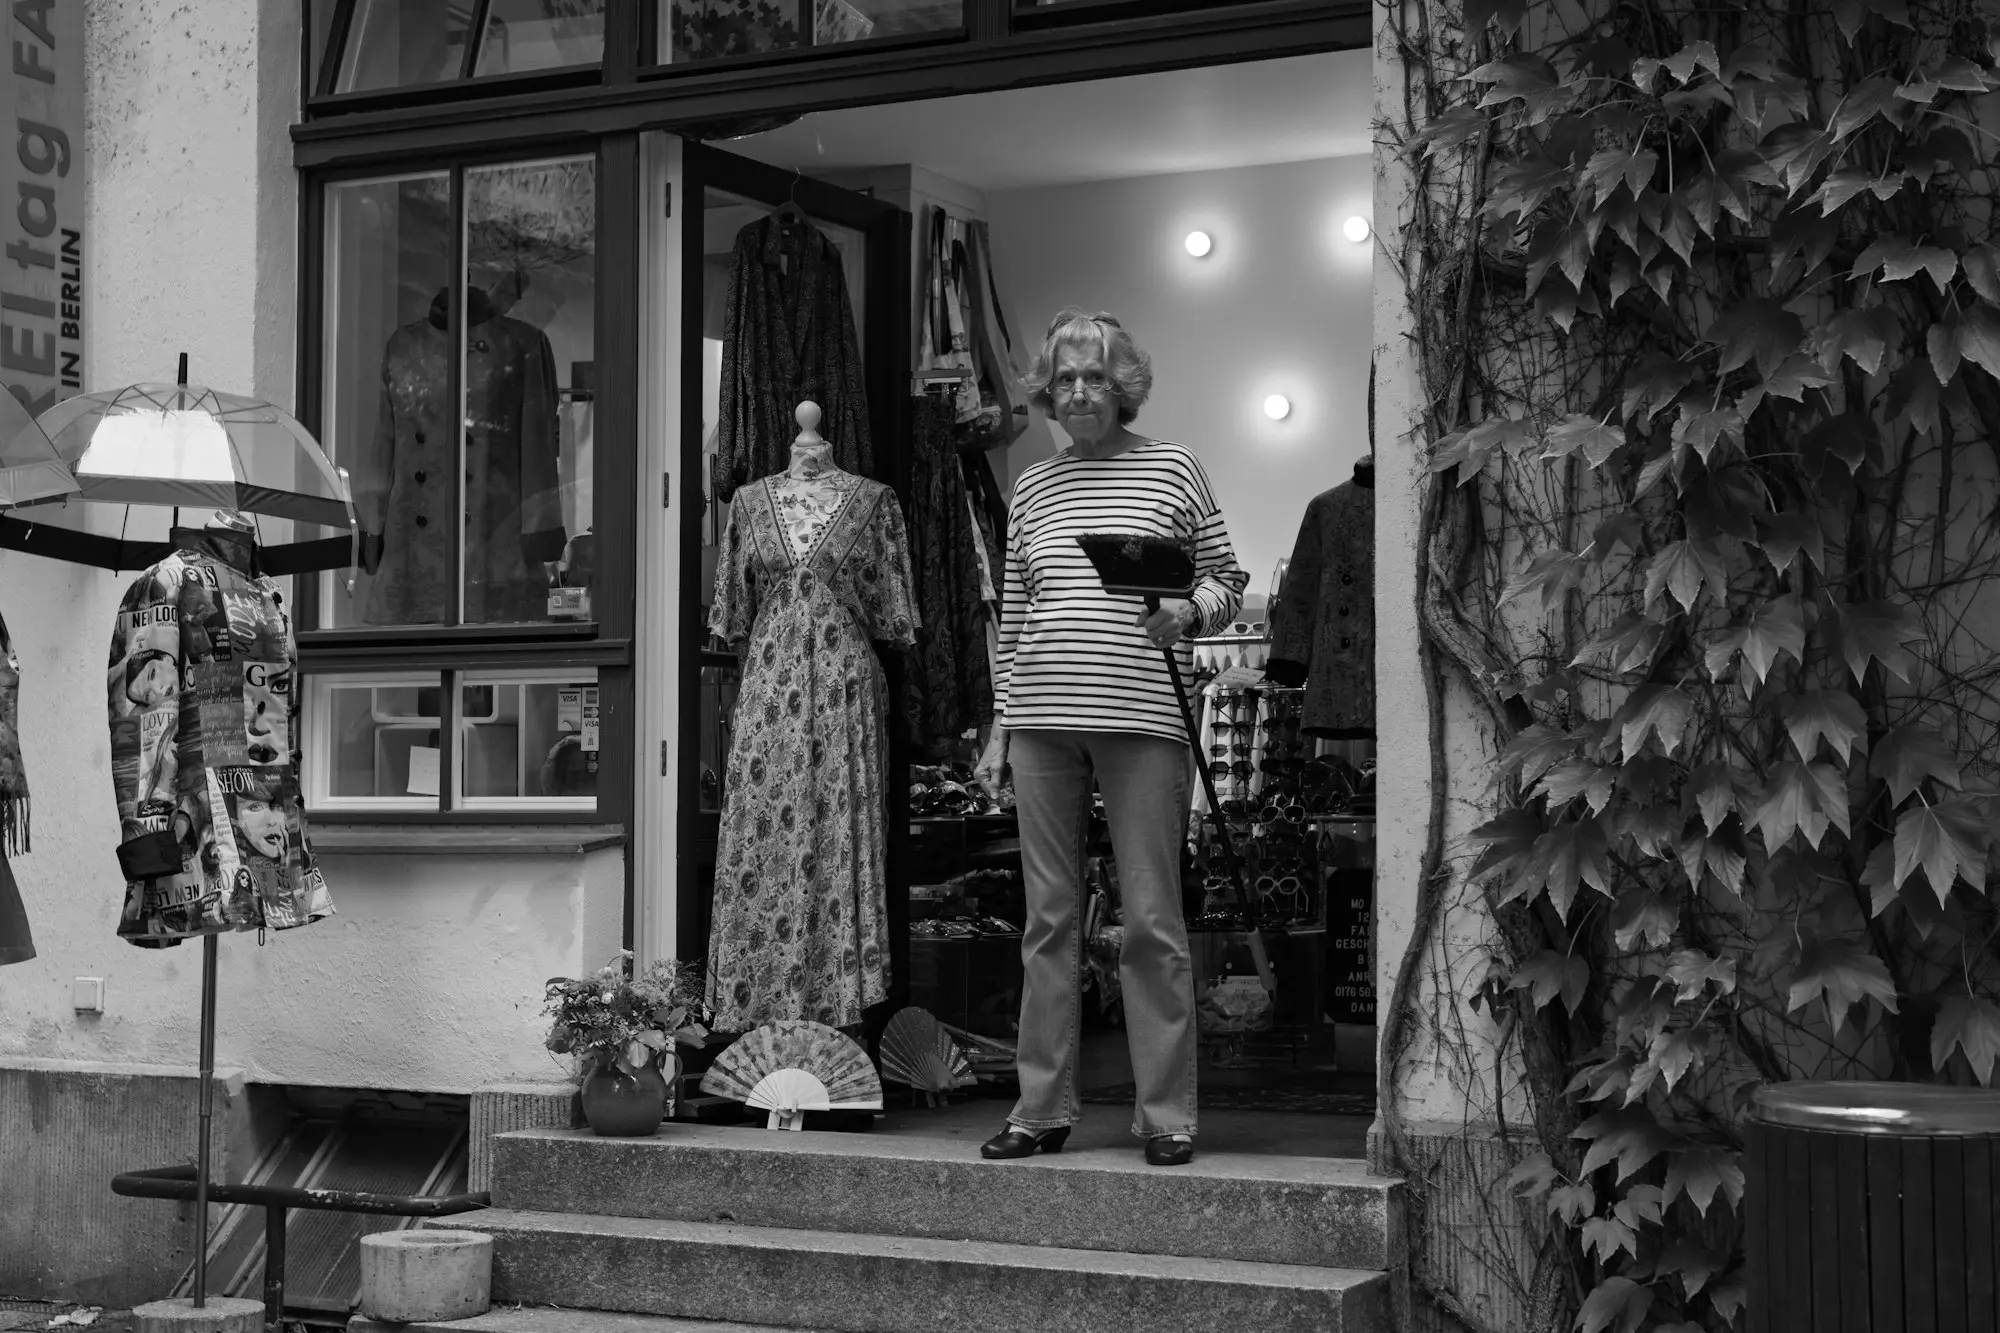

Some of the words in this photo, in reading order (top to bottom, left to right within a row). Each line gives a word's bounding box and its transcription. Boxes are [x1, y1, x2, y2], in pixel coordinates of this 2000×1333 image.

[61, 228, 80, 340] BERLIN
[61, 351, 80, 388] IN
[217, 772, 255, 794] SHOW
[1351, 898, 1364, 909] MO
[1358, 911, 1370, 922] 12
